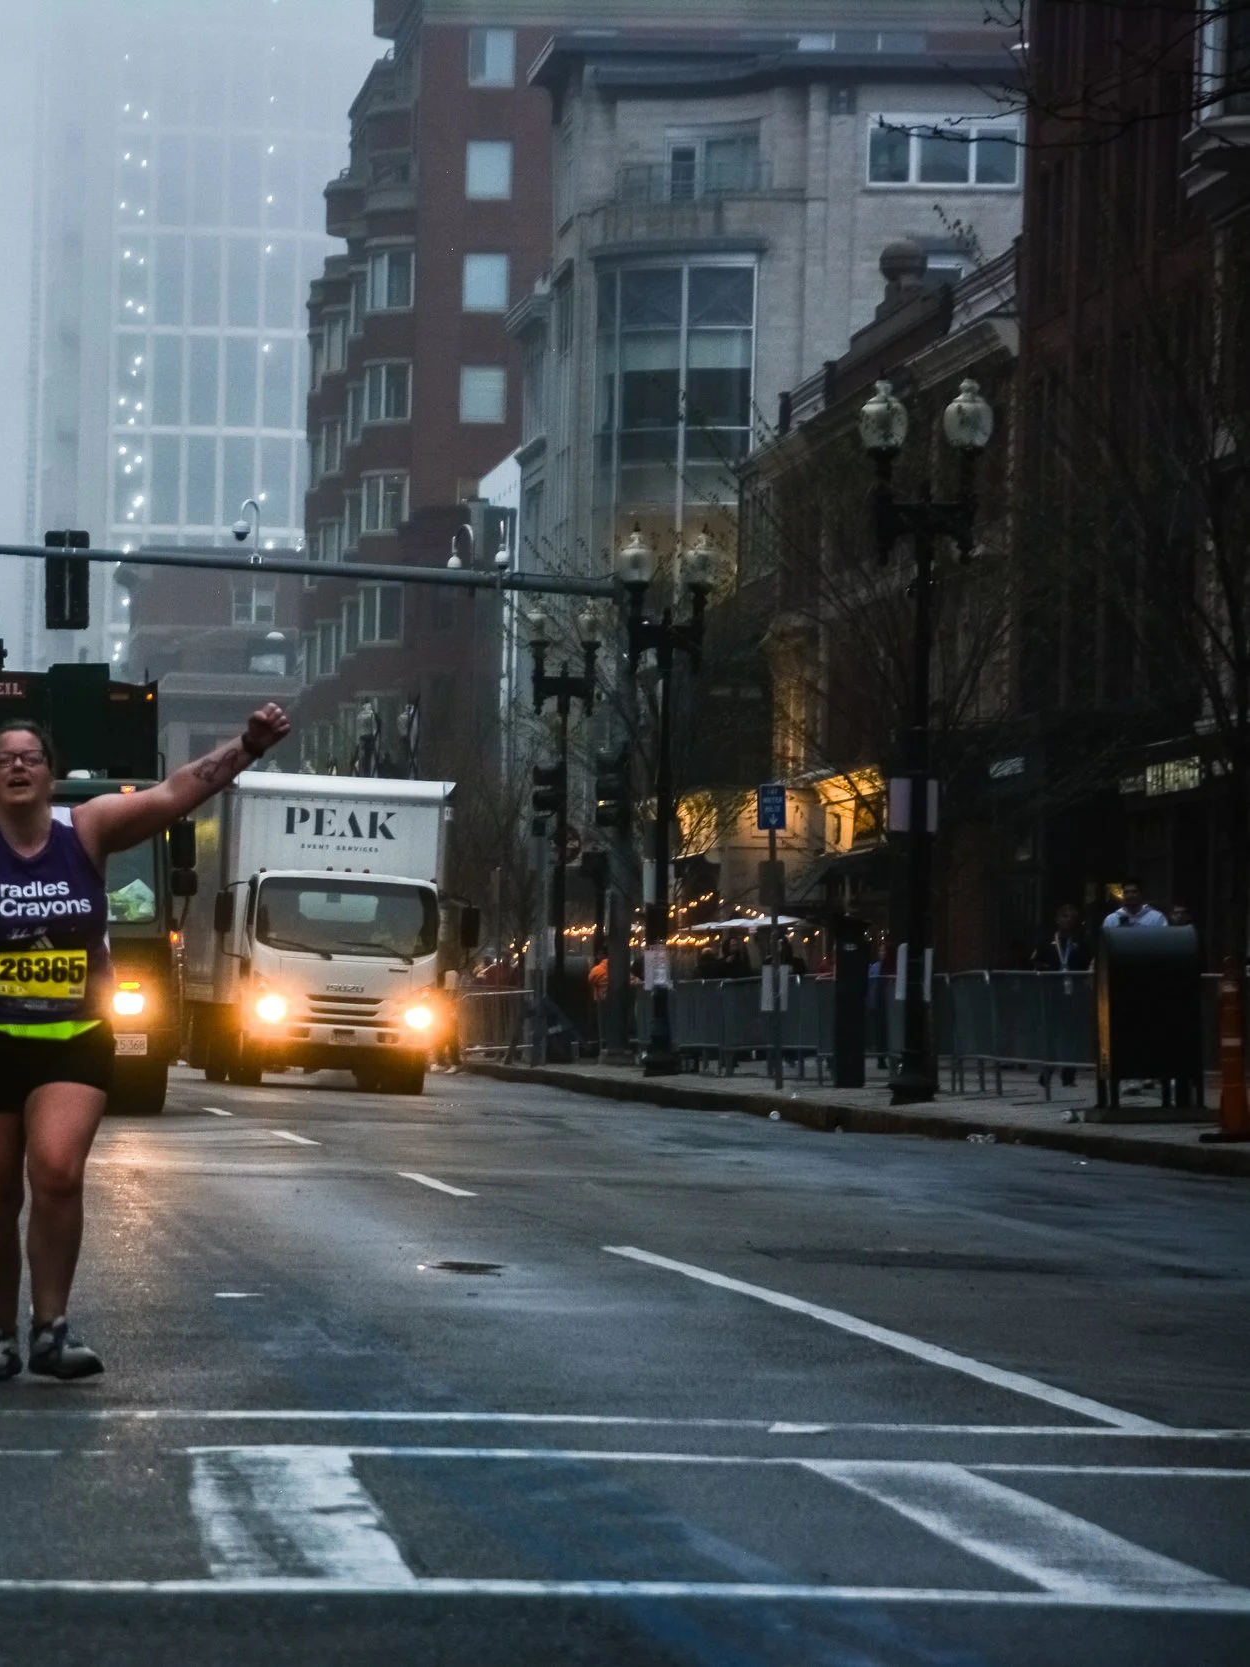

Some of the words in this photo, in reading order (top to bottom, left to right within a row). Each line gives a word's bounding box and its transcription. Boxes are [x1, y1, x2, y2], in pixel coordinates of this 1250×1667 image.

[286, 806, 397, 840] PEAK
[336, 845, 379, 853] SERVICES
[0, 956, 86, 984] 26365
[326, 984, 365, 993] ISUZU
